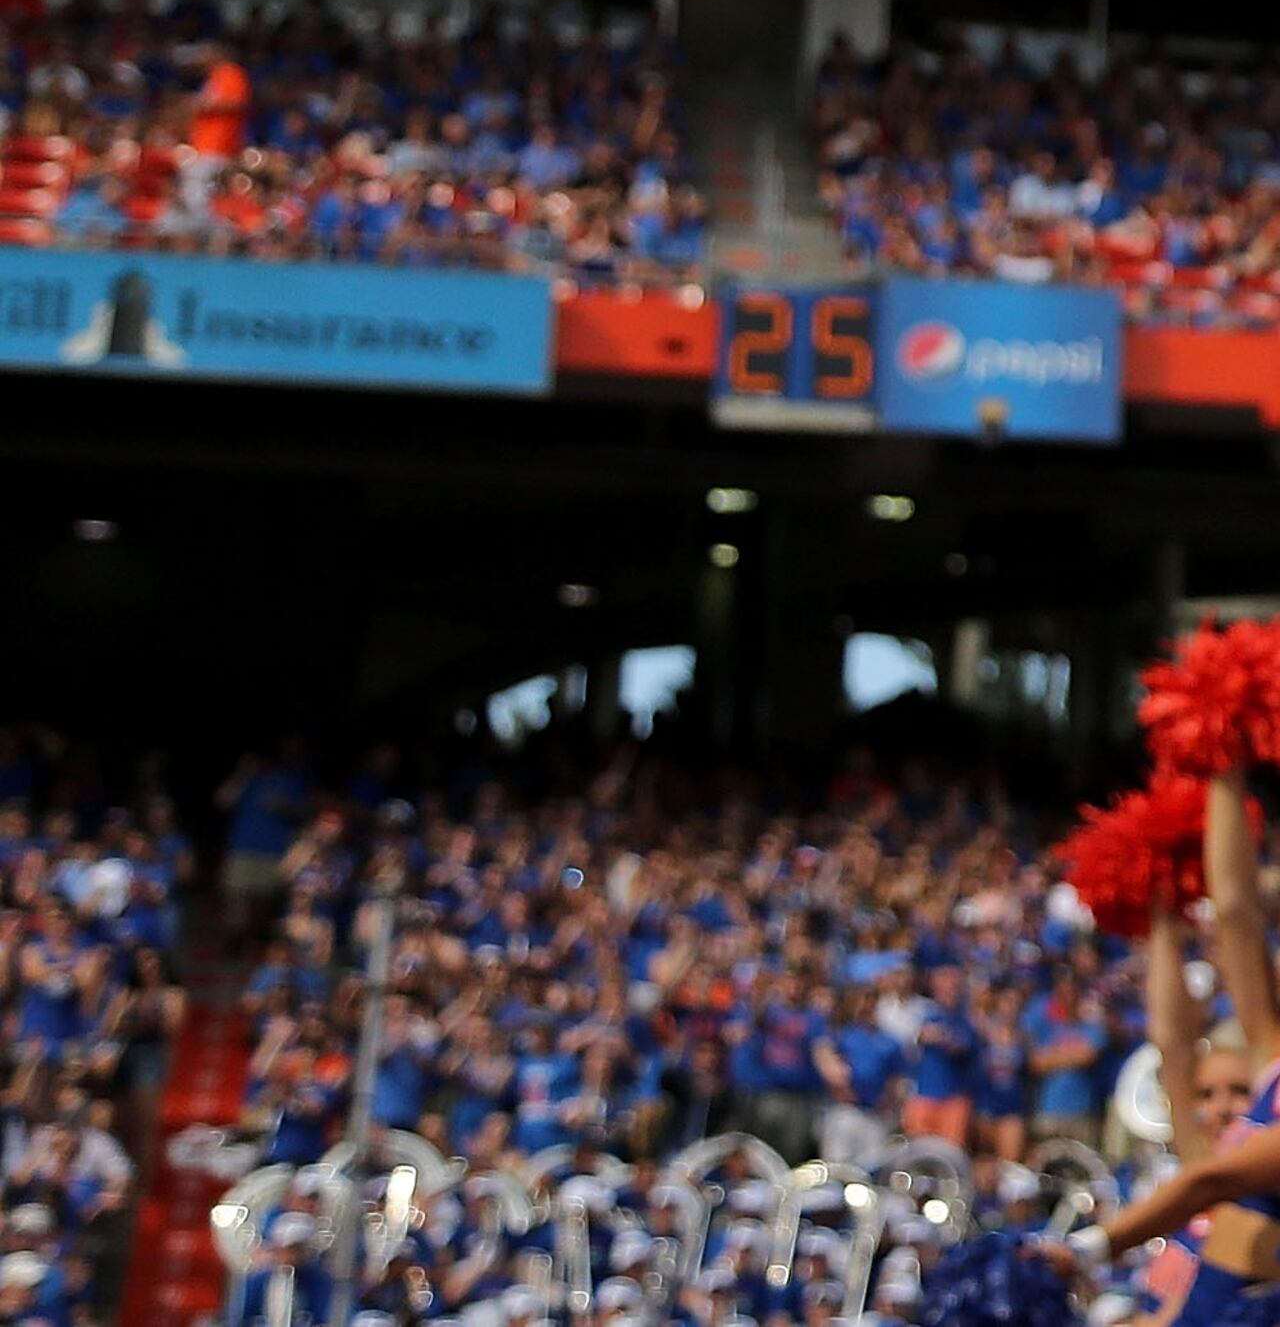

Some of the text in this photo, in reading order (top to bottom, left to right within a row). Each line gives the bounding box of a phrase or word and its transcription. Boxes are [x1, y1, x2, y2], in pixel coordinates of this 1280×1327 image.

[0, 276, 496, 354] ill Insurance
[728, 291, 873, 398] 25
[965, 337, 1103, 387] pepsi
